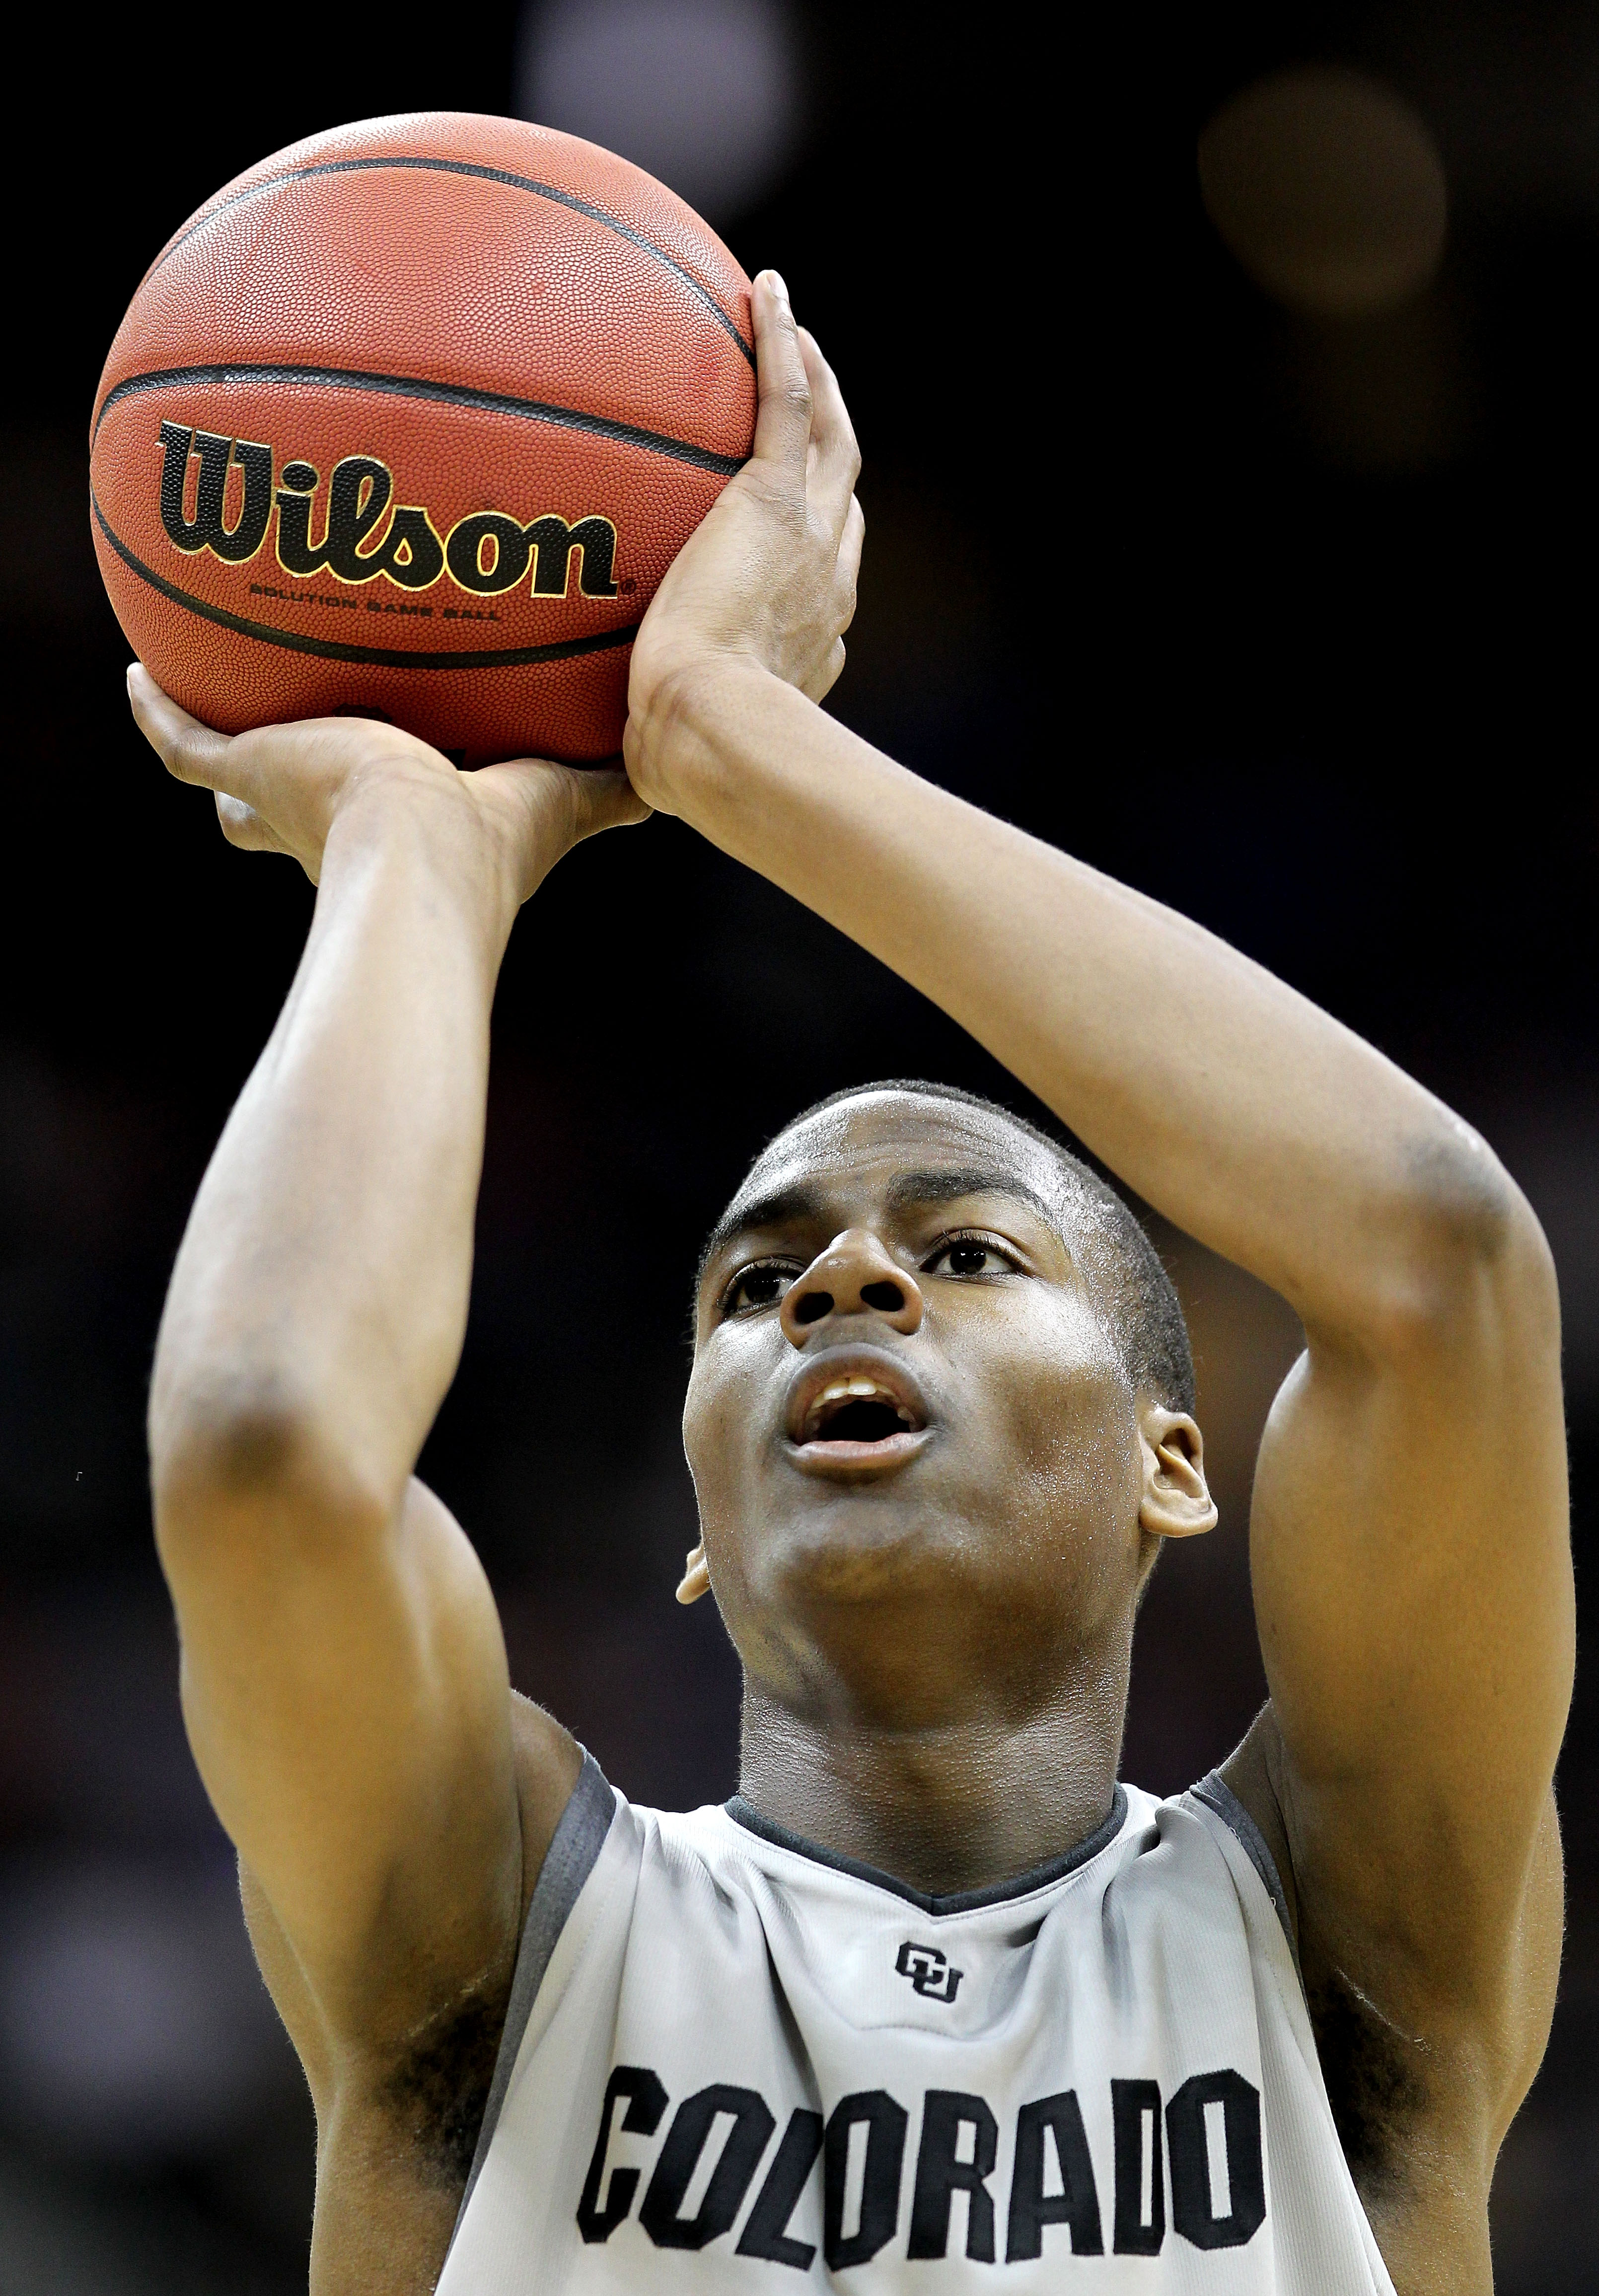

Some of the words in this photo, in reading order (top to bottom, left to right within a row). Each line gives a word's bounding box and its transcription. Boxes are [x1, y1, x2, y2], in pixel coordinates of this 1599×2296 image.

[156, 420, 620, 599] Wilson
[250, 583, 357, 609] SOLUTION
[366, 601, 432, 617] GAME
[443, 608, 500, 621] BALL
[895, 1941, 964, 2004] CU
[576, 2066, 1267, 2272] COLORADO
